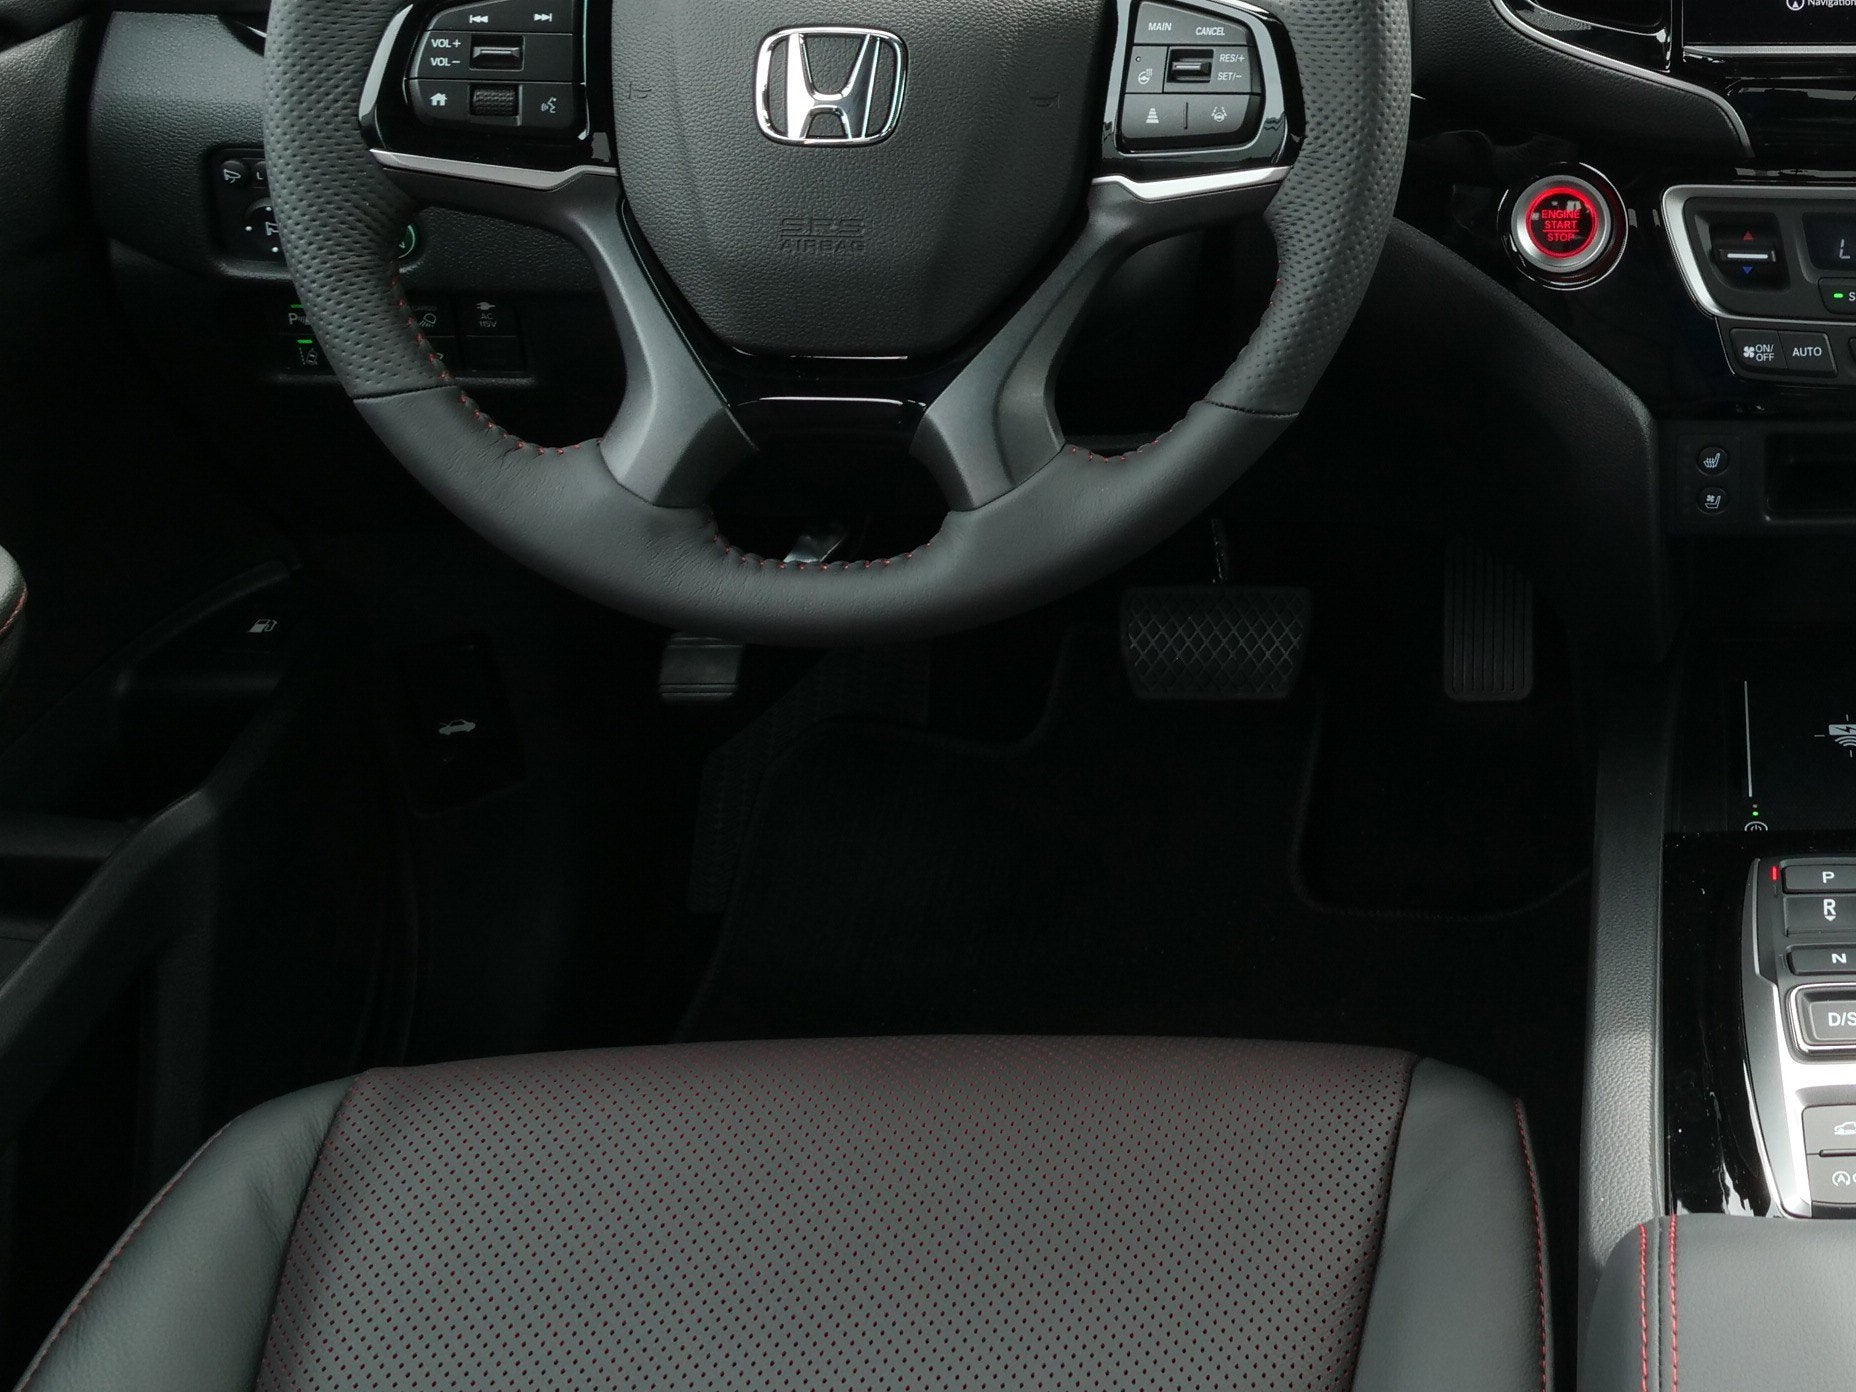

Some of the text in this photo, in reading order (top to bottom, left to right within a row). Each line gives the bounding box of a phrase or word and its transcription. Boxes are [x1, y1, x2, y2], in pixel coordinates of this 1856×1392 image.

[1148, 22, 1172, 31] MAIN
[1195, 27, 1226, 36] CANCEL
[1220, 54, 1245, 62] RES/+
[1542, 210, 1580, 219] ENGINE
[1544, 220, 1578, 229] START
[1547, 233, 1576, 242] STOP
[780, 239, 866, 252] AIRBAG
[1755, 344, 1774, 354] ON/
[1792, 347, 1822, 358] AUTO
[1756, 353, 1775, 362] OFF
[1822, 871, 1835, 884] P
[1823, 898, 1836, 916] R
[1831, 952, 1848, 964] N
